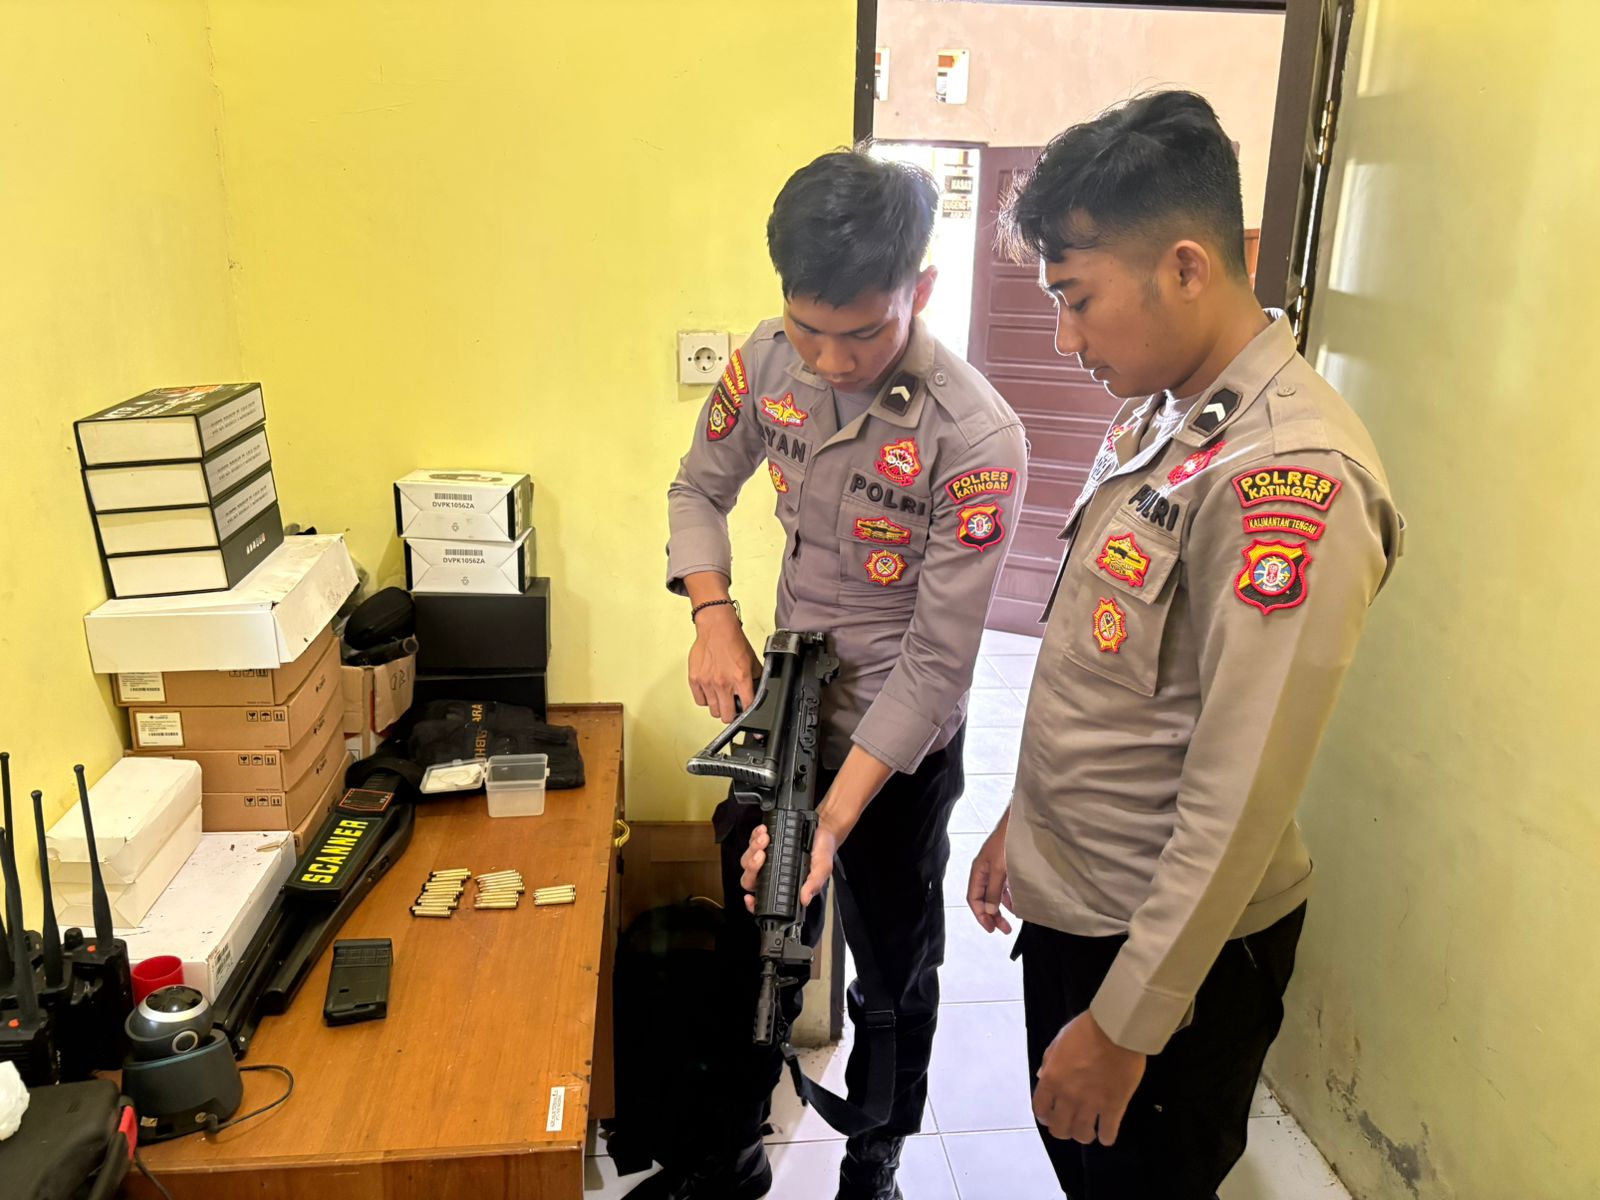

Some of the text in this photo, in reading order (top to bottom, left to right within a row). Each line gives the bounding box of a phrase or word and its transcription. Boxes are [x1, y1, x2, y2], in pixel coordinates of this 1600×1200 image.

[952, 471, 1009, 490] POLRES
[956, 482, 1008, 498] KATINGAN
[1240, 471, 1332, 494] POLRES
[850, 473, 926, 516] POLRI
[1248, 485, 1324, 503] KATINGAN
[1248, 517, 1318, 535] KALIMANTAN TENGAH
[301, 820, 369, 884] SCANNER
